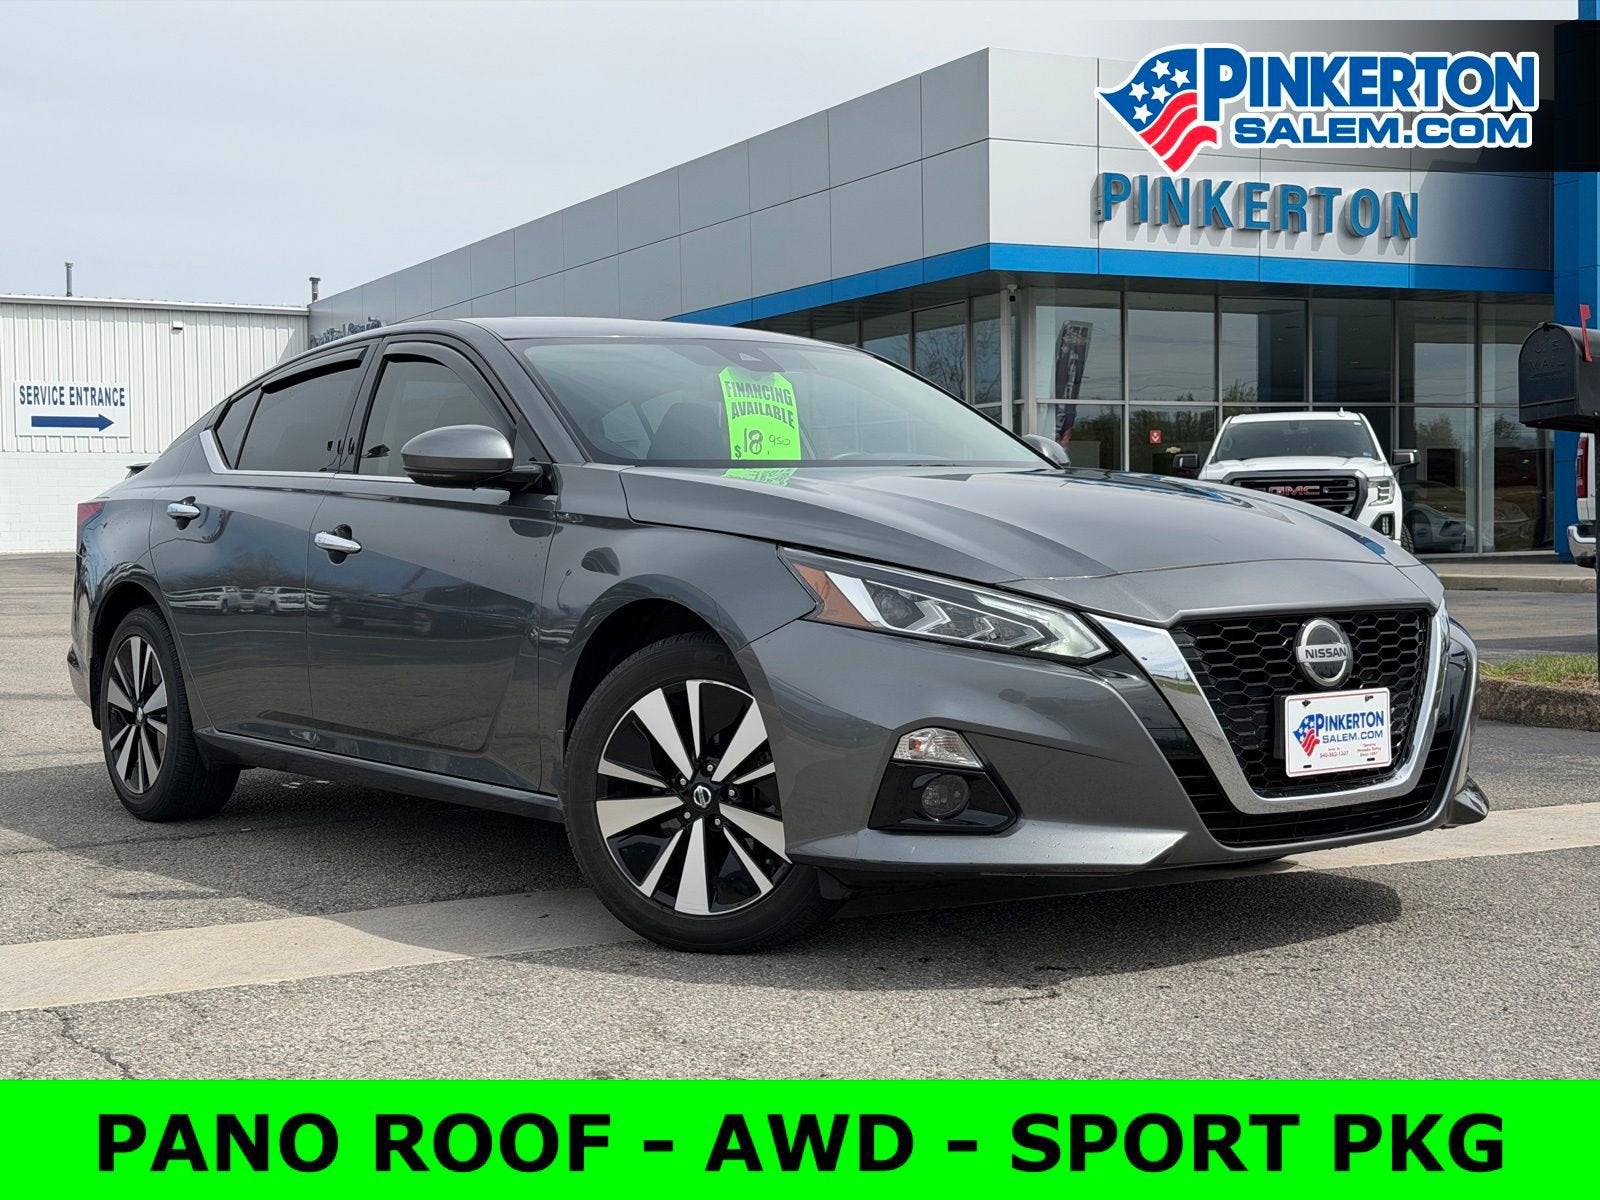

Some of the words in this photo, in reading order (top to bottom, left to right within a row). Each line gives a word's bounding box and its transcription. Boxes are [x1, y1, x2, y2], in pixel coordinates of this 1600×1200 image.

[1099, 171, 1419, 239] PINKERTON
[19, 384, 65, 405] SERVICE
[69, 386, 125, 407] ENTRANCE
[724, 380, 793, 407] FINANCING
[731, 401, 795, 429] AVAILABLE
[1268, 485, 1320, 496] GMC
[1305, 646, 1347, 659] NISSAN
[1315, 710, 1385, 737] PINKERTON
[1322, 730, 1383, 744] SALEM.COM
